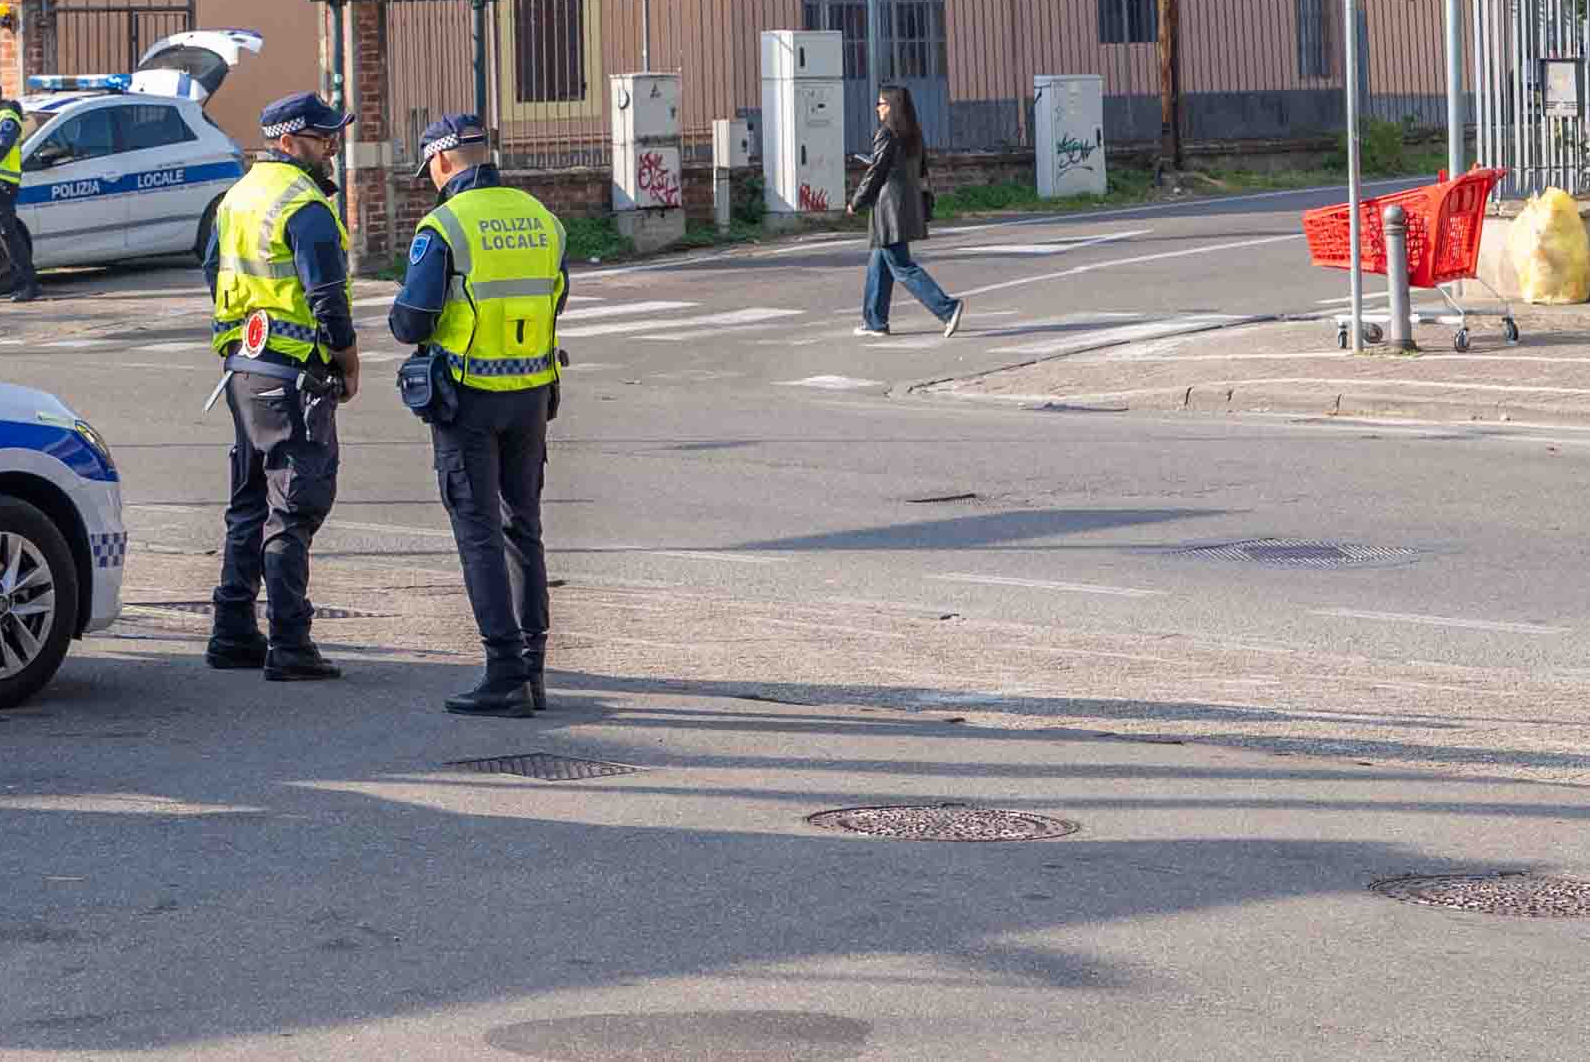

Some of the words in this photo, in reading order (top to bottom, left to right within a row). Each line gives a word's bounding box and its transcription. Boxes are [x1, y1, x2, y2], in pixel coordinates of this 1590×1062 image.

[51, 181, 100, 199] POLIZIA
[137, 169, 185, 188] LOCALE
[479, 218, 544, 233] POLIZIA
[482, 233, 547, 250] LOCALE
